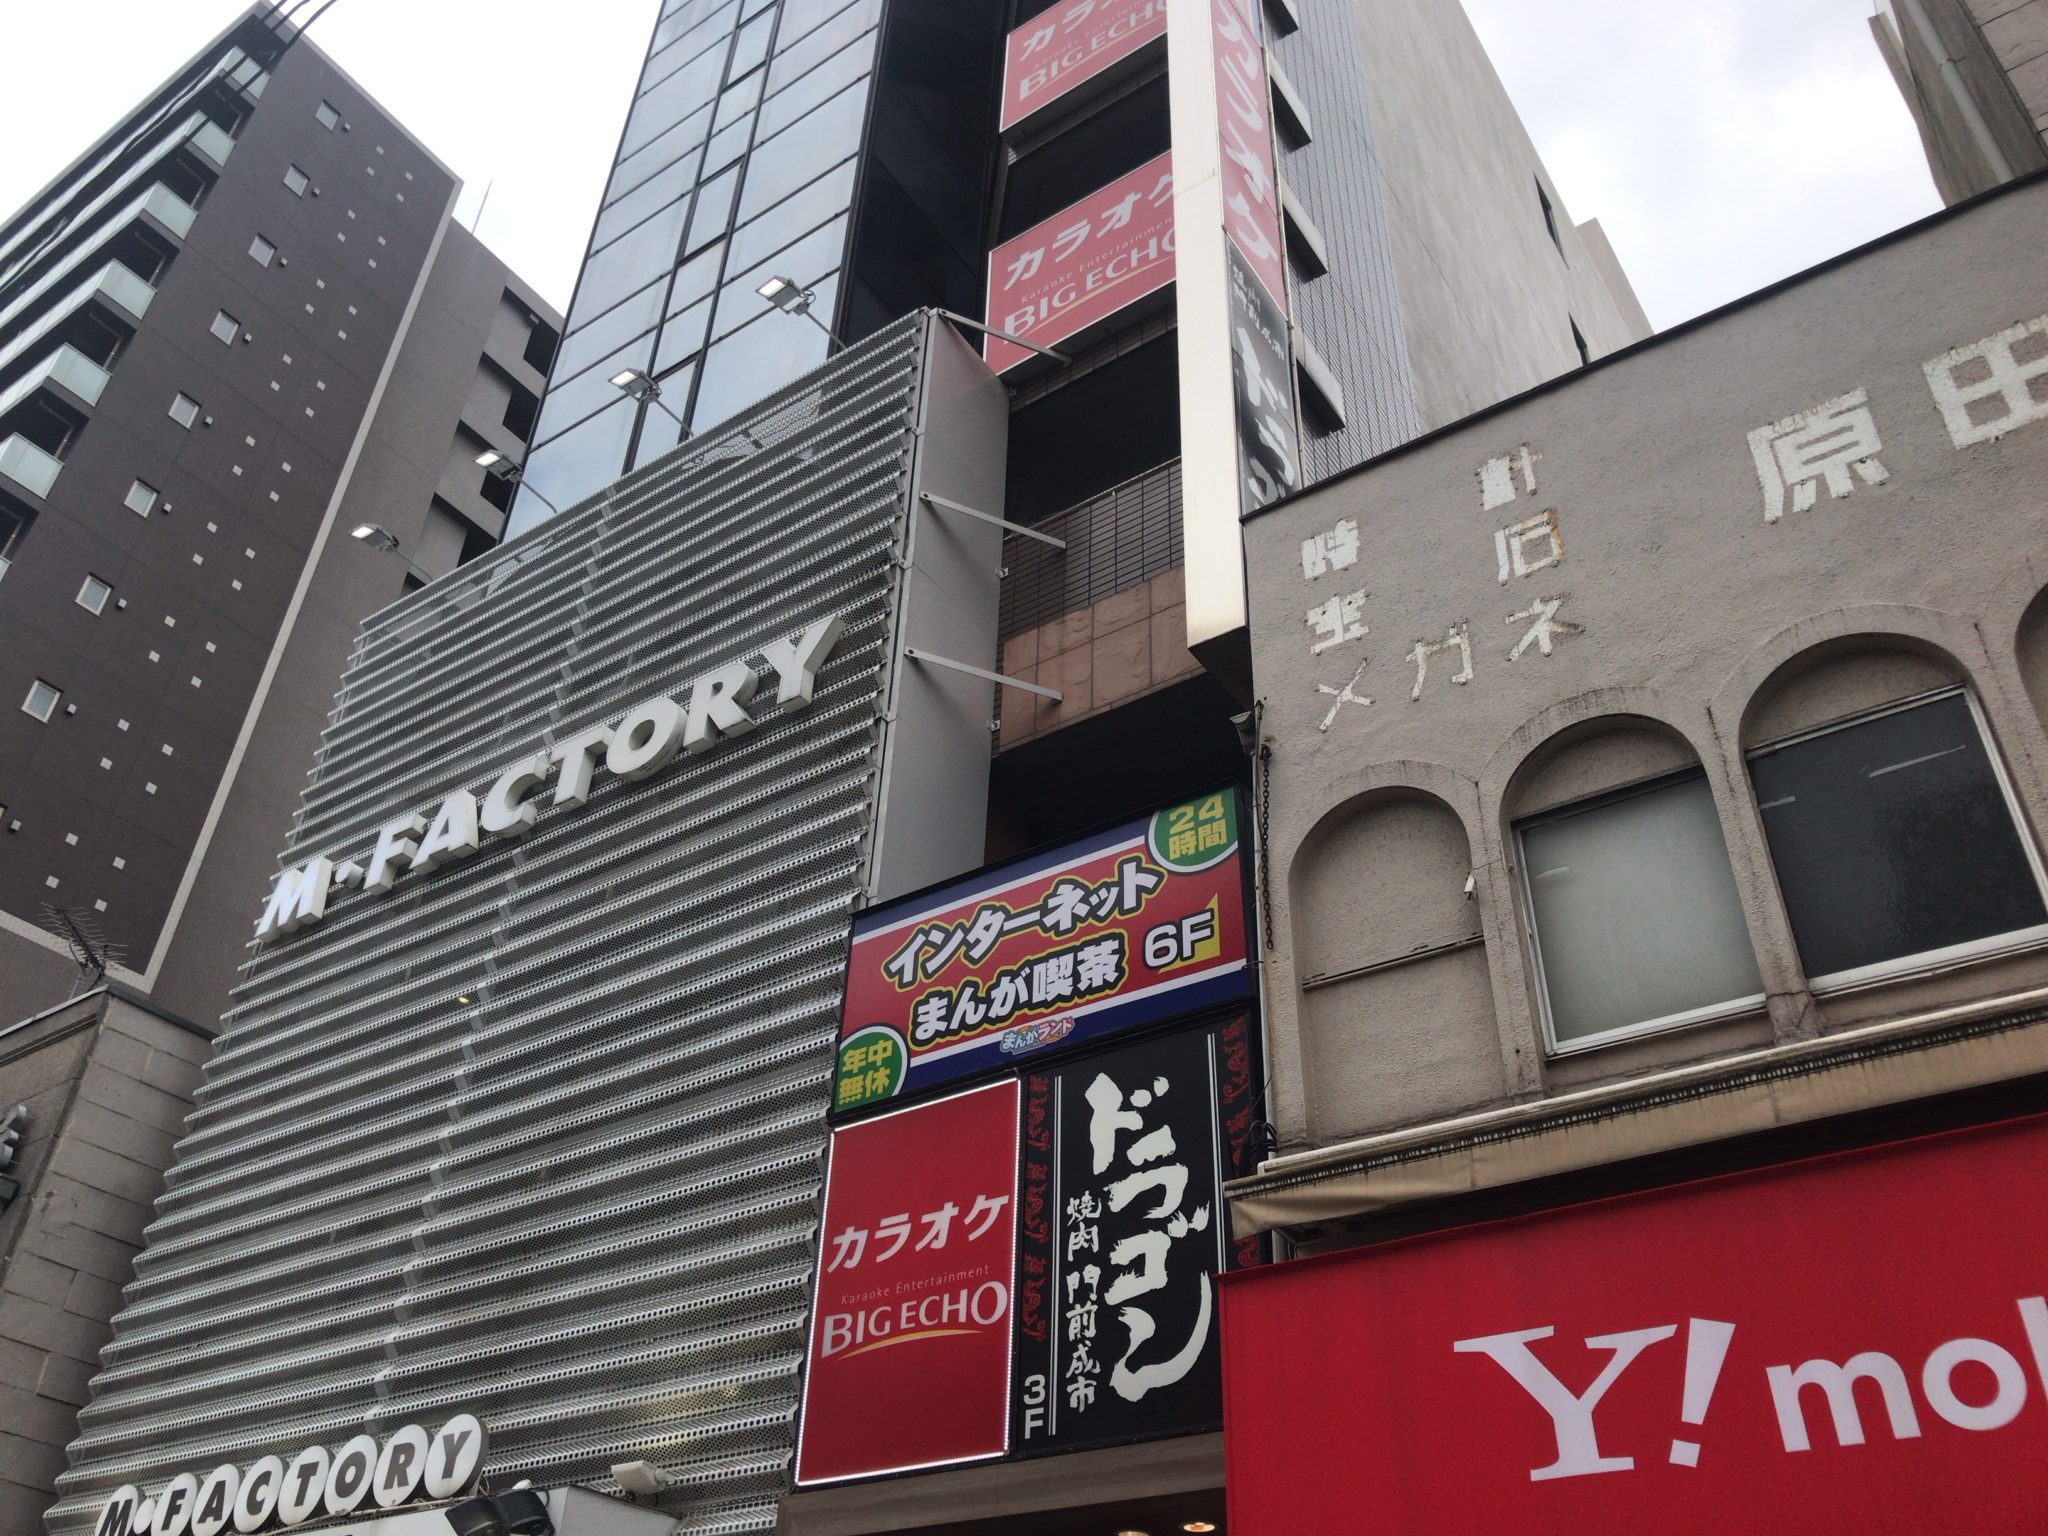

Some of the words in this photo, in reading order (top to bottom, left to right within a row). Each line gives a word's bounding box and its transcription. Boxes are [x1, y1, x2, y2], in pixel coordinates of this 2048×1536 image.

[1019, 45, 1084, 101] BIG
[1003, 282, 1077, 345] BIG
[1021, 272, 1073, 305] Karaoke
[1168, 793, 1225, 836] 24
[1168, 818, 1228, 861] 時間
[886, 858, 1162, 988] インターネット
[1143, 909, 1214, 969] 6F
[913, 938, 1127, 1042] まんが喫茶
[842, 1039, 893, 1074] 年中
[1001, 1016, 1073, 1051] まんがランド
[839, 1067, 891, 1105] 無休
[826, 1193, 1010, 1274] カラオケ
[1066, 1189, 1102, 1263] 焼肉
[1084, 1071, 1213, 1403] ドラゴン
[841, 1286, 890, 1305] Karaoke
[895, 1263, 990, 1295] Entertainment
[821, 1305, 892, 1359] BIG
[899, 1280, 1009, 1330] ECHO
[1065, 1263, 1102, 1414] 門前成市
[1023, 1373, 1047, 1440] 3F
[1453, 1316, 1737, 1482] Y!
